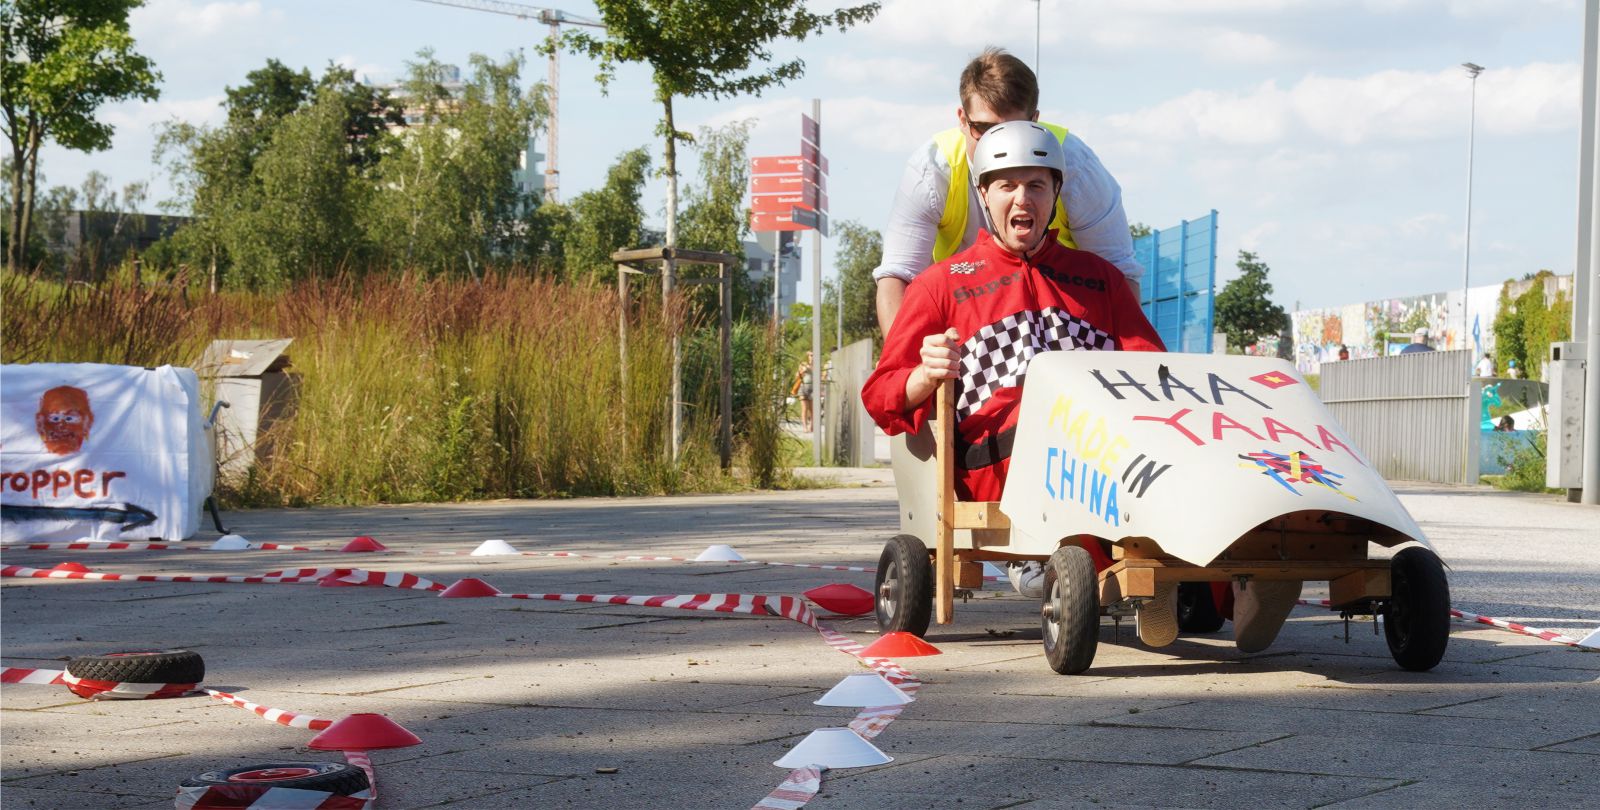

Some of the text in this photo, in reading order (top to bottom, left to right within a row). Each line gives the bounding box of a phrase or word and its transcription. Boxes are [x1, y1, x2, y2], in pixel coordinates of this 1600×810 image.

[952, 270, 1023, 304] Super
[1088, 364, 1272, 409] HAA
[1048, 394, 1173, 498] MADE IN
[1132, 408, 1368, 468] YAAA
[1045, 447, 1119, 527] CHINA
